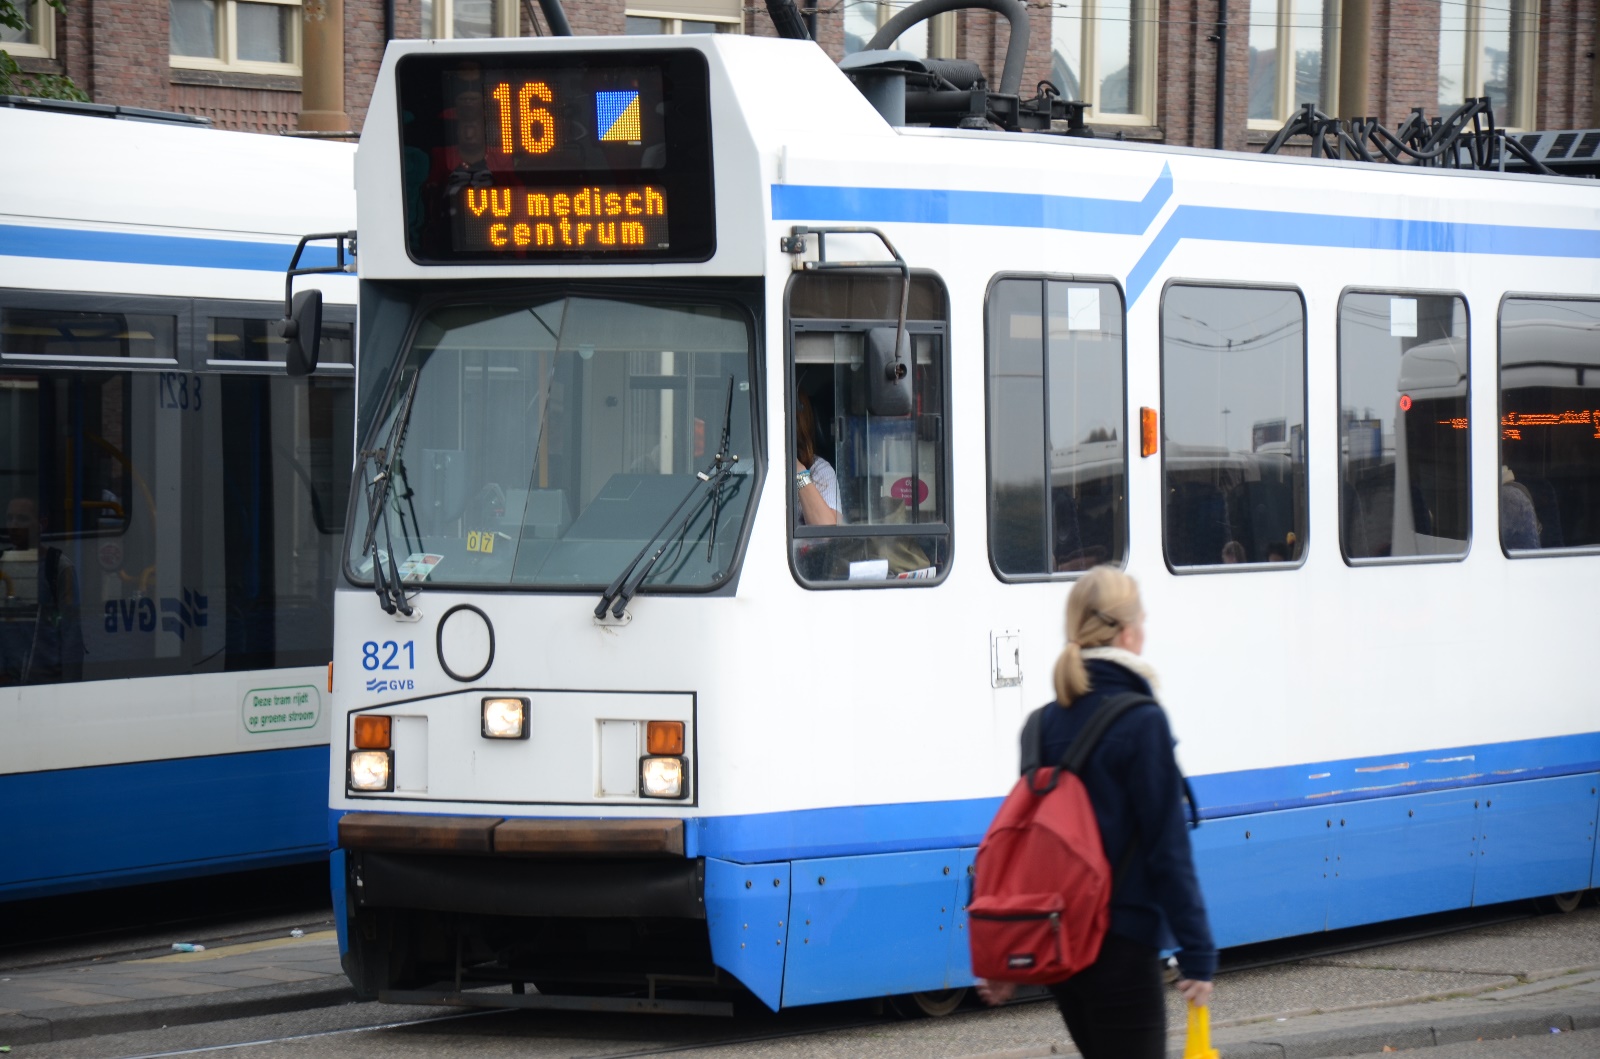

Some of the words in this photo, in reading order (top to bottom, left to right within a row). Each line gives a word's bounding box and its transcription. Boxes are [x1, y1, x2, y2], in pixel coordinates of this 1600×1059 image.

[493, 82, 554, 153] 16
[466, 188, 511, 216] VU
[527, 187, 663, 216] medisch
[489, 217, 645, 245] centrum
[361, 640, 415, 671] 821
[389, 679, 415, 691] GVB
[253, 695, 272, 707] Deze
[273, 695, 291, 705] tram
[293, 692, 309, 706] rijdt
[249, 716, 259, 727] op
[260, 714, 287, 727] groene
[288, 711, 314, 722] stroom
